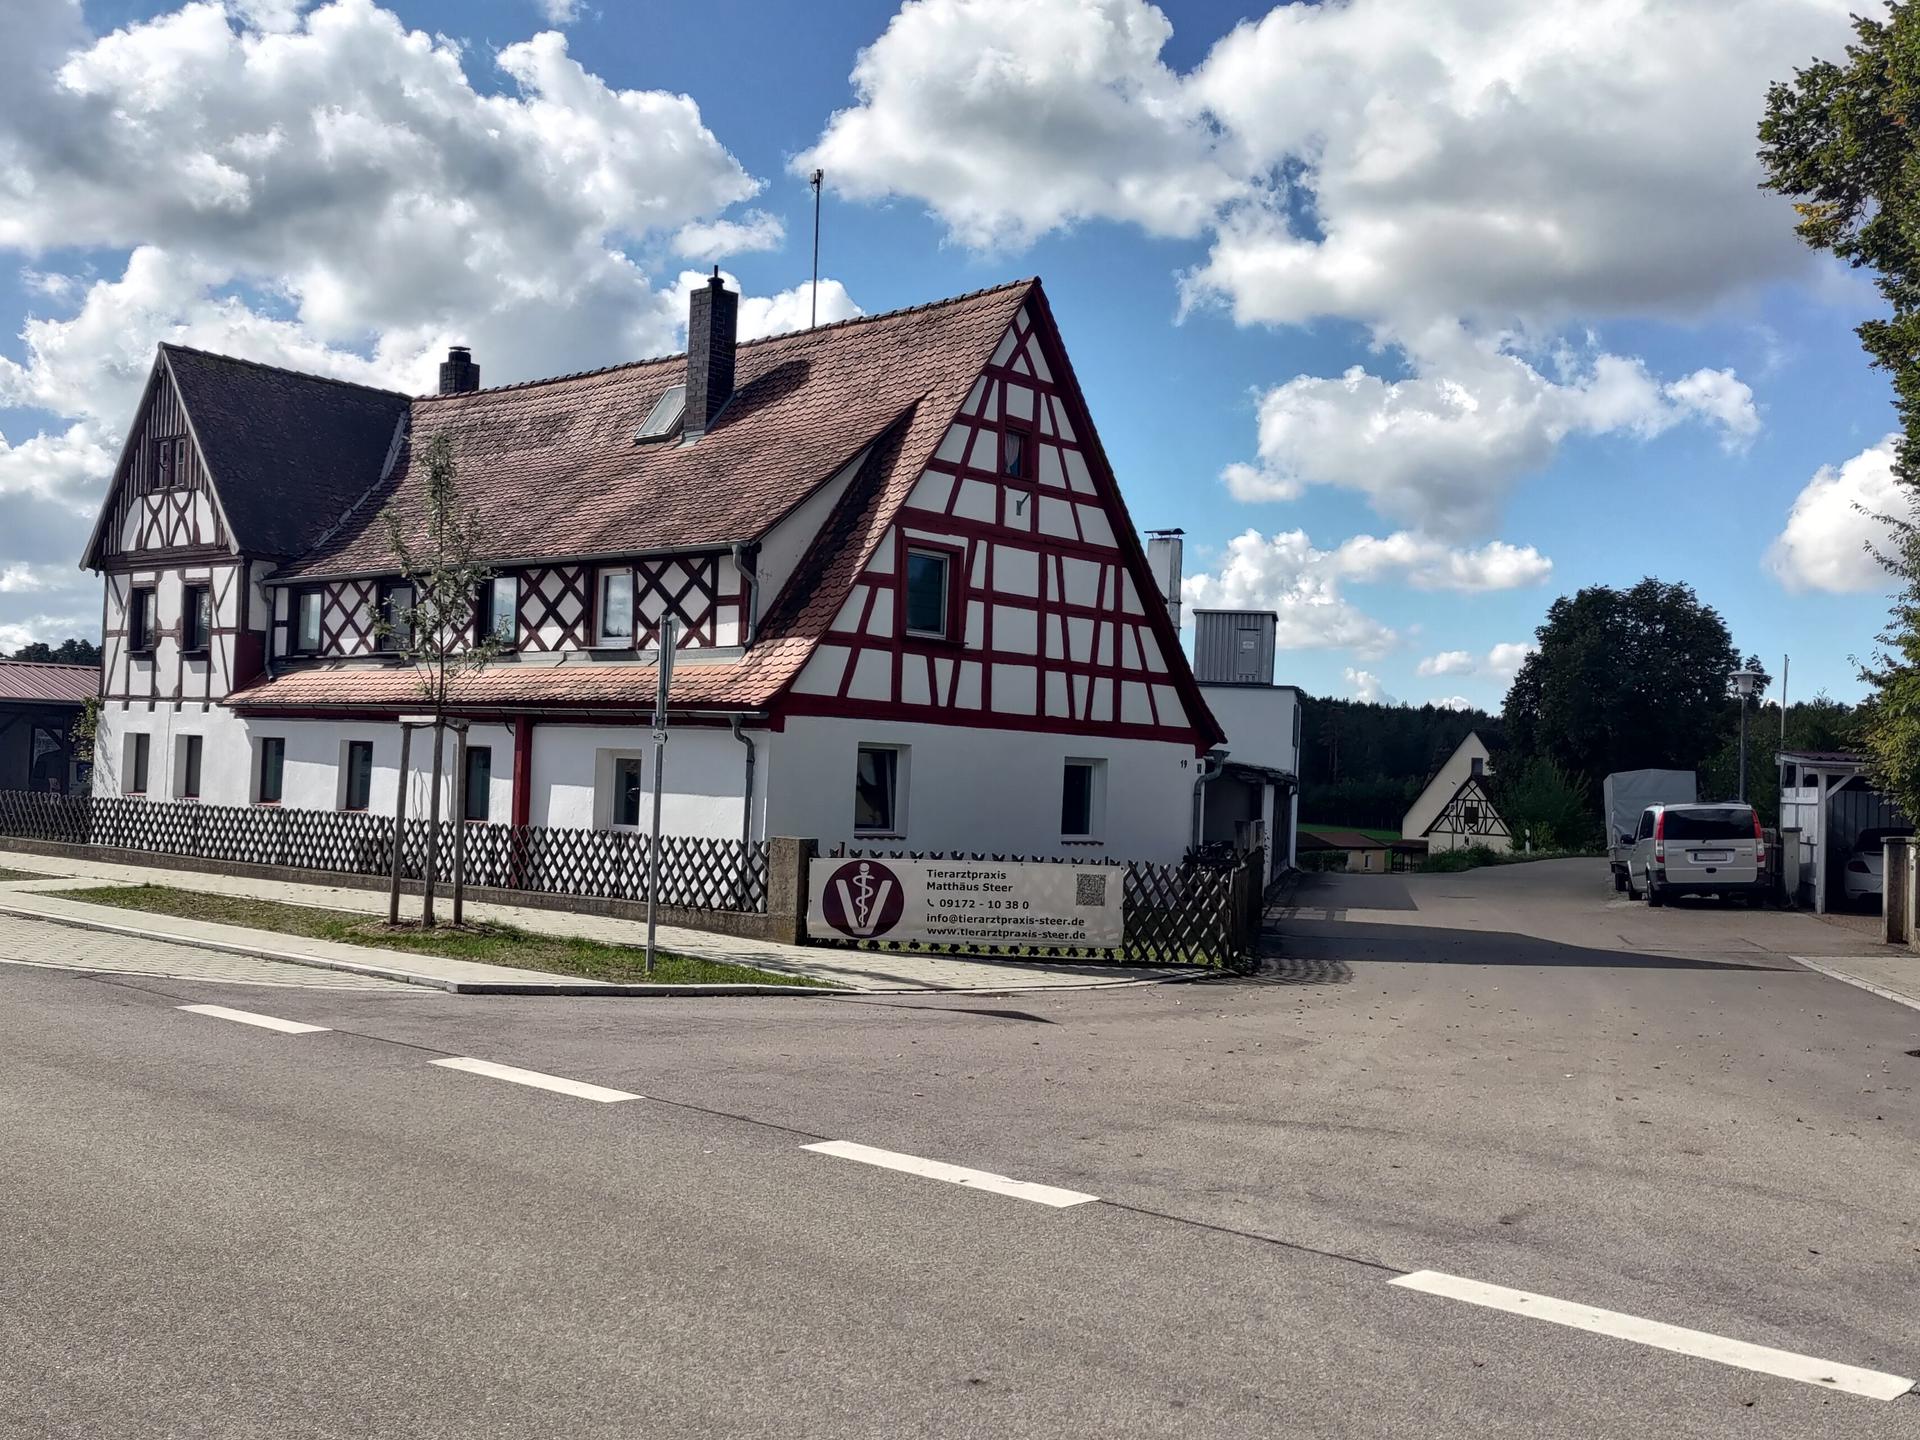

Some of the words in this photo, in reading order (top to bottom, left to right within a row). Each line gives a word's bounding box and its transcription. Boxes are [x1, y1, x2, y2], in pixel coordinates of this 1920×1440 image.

[926, 869, 1006, 881] Tierarztpraxis
[926, 881, 979, 891] Matthäus
[982, 882, 1014, 892] Steer
[939, 899, 975, 909] 09172
[988, 900, 1002, 909] 10
[1005, 900, 1019, 909] 38
[1022, 901, 1030, 910] 0
[926, 913, 1085, 926] info@tierarztpraxis-steer.de
[926, 928, 1086, 940] www.tierarztpraxis-steer.de
